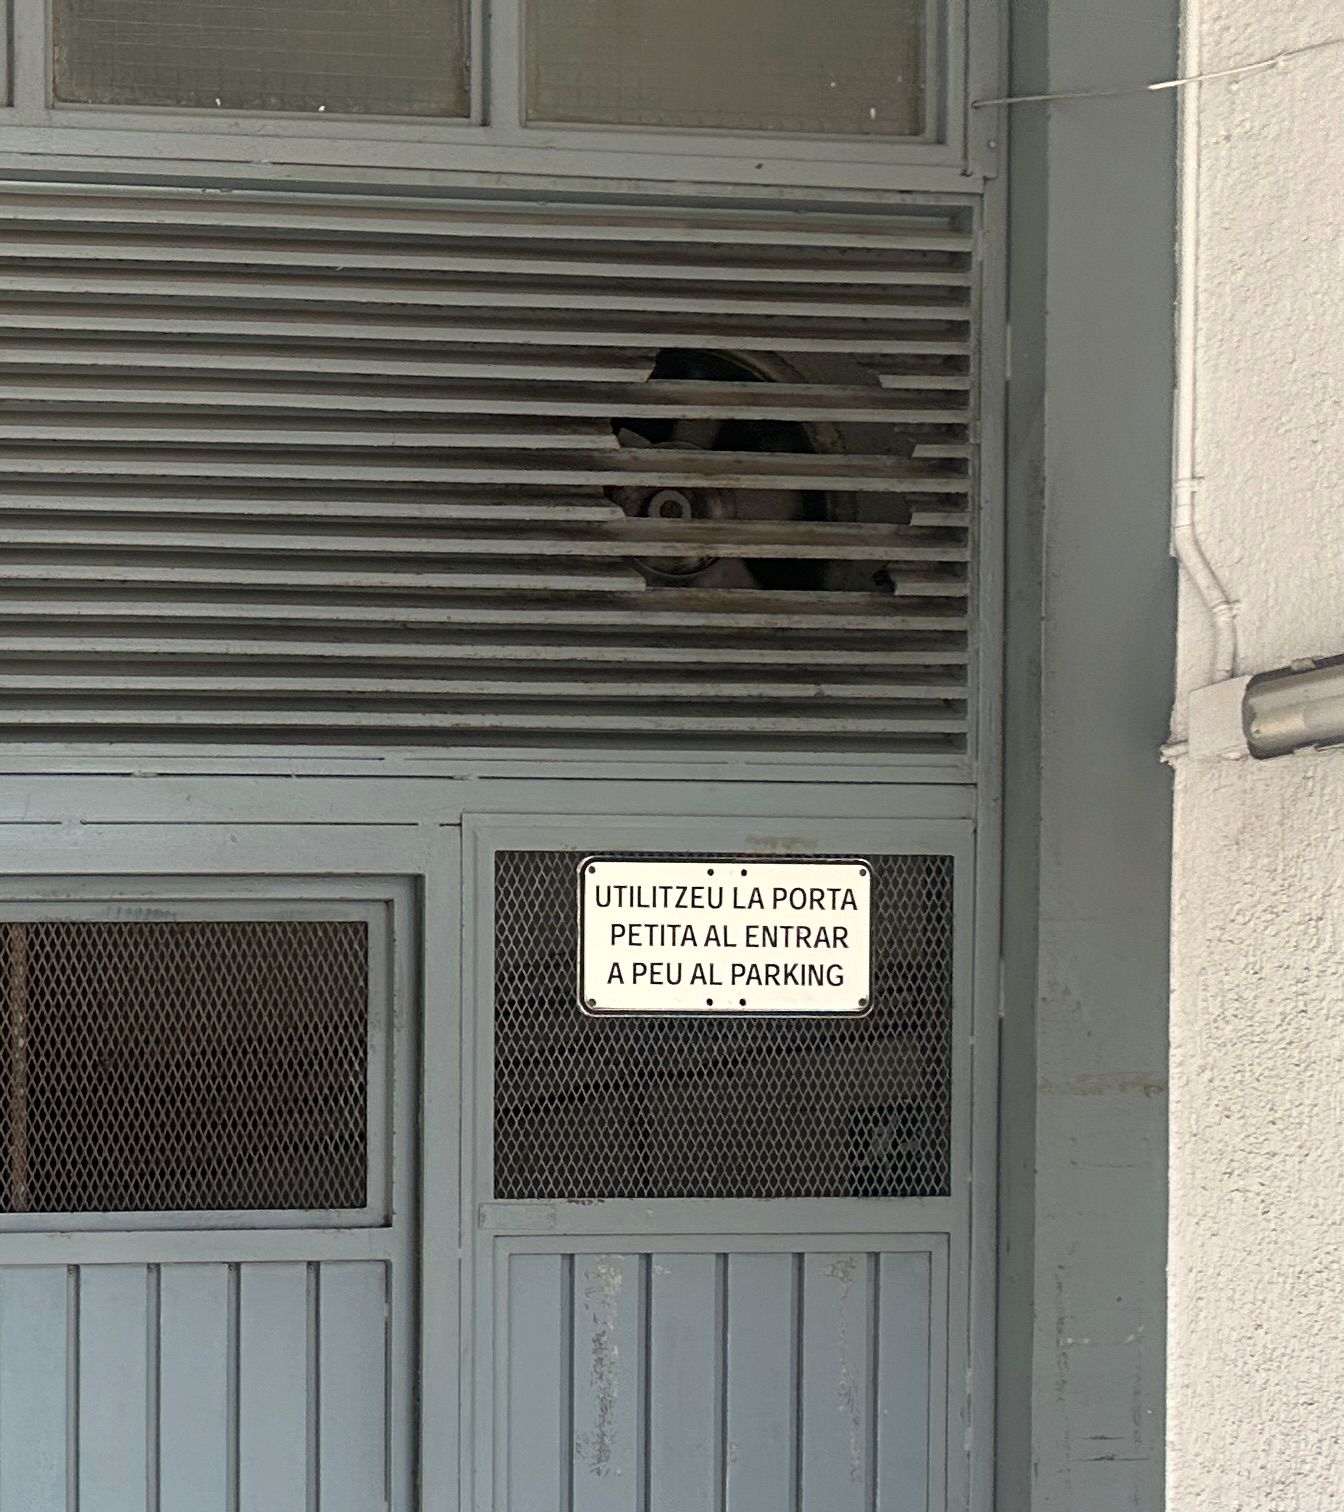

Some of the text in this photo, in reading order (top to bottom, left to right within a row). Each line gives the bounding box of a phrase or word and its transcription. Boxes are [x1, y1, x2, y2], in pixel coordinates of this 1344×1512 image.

[595, 885, 858, 911] UTILITZEU LA PORTA
[610, 923, 850, 949] PETITA AL ENTRAR
[607, 962, 845, 987] A PEU AL PARKING
